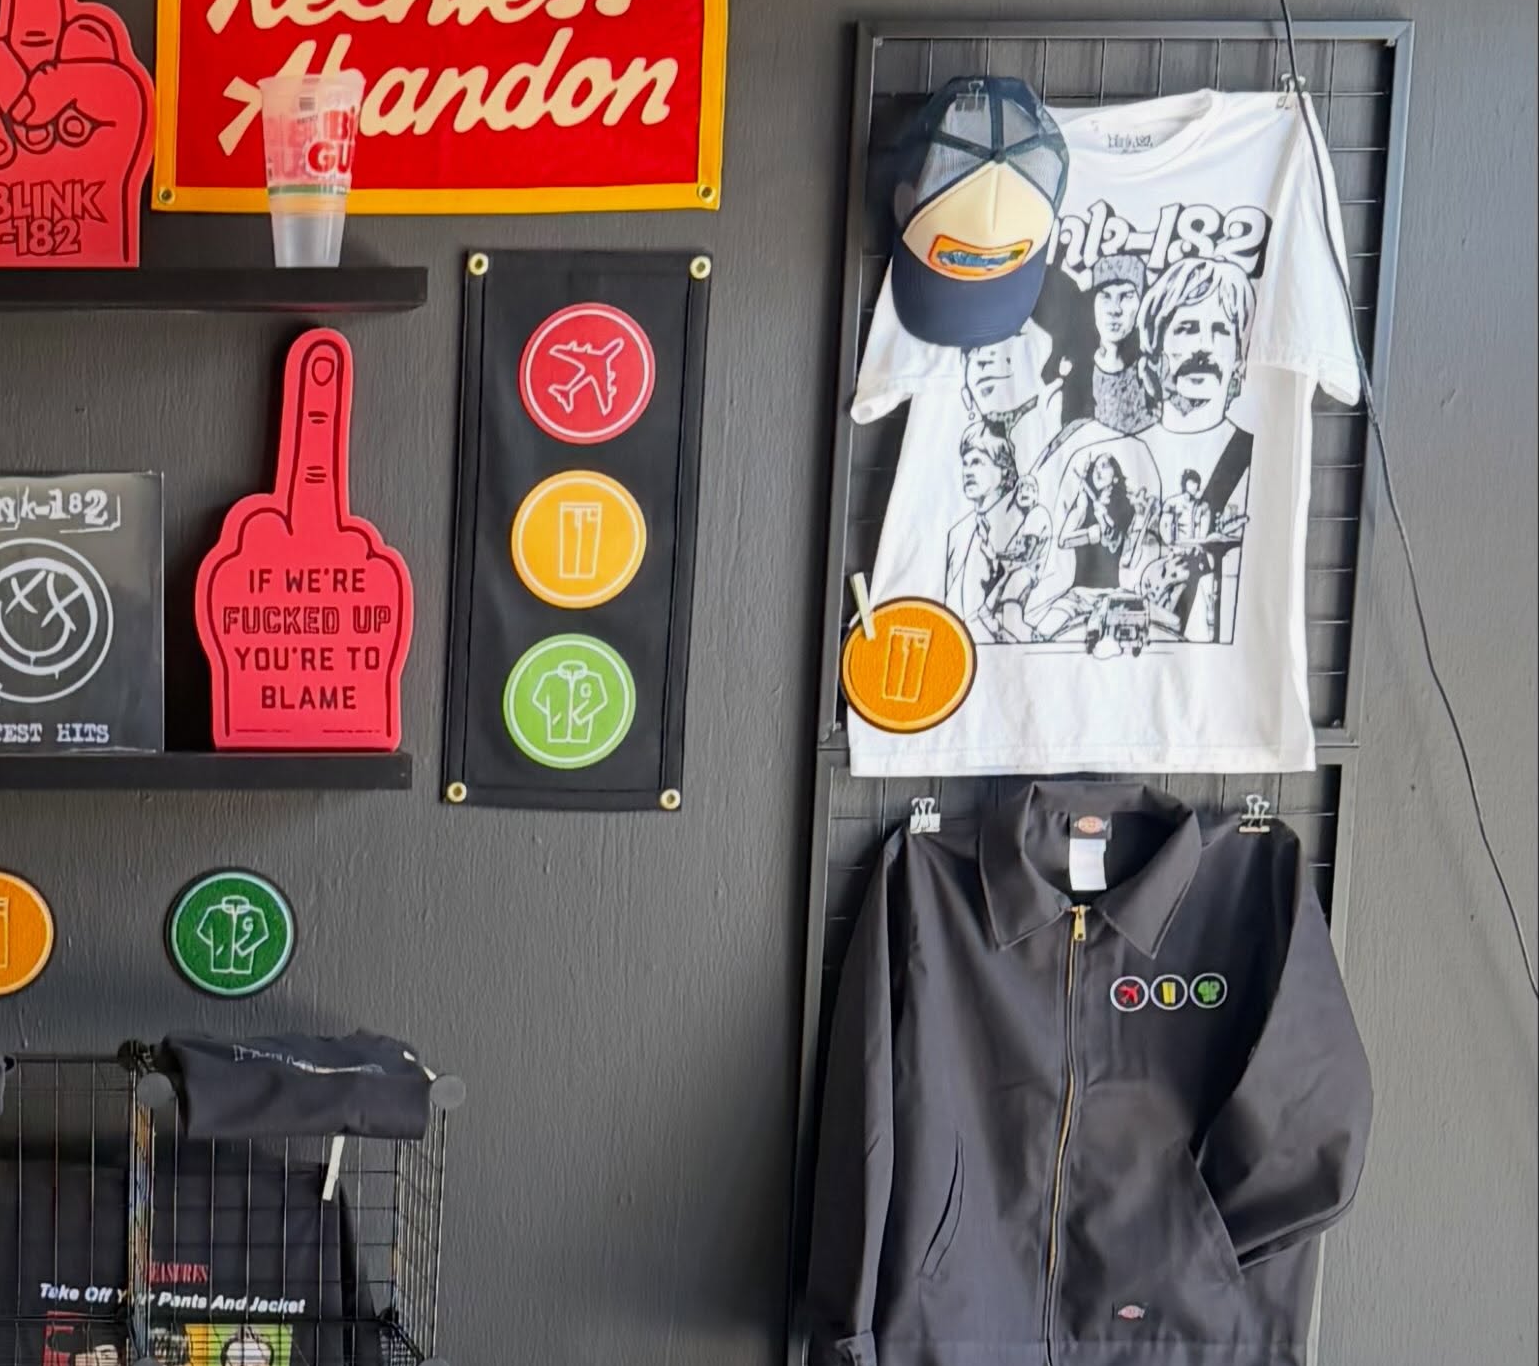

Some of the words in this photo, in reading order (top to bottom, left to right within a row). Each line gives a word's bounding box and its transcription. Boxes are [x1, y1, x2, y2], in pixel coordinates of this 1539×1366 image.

[1046, 198, 1273, 285] nk-182
[249, 568, 273, 594] IF
[285, 567, 366, 594] WE'RE
[223, 606, 340, 635] FUCKED
[352, 605, 392, 634] UP
[234, 646, 334, 671] YOU'RE
[346, 646, 380, 671] TO
[261, 685, 357, 710] BLAME
[56, 722, 110, 744] HITS
[40, 1283, 80, 1302] Take
[84, 1286, 114, 1304] Off
[157, 1291, 208, 1309] Pants
[211, 1294, 248, 1312] And
[249, 1296, 307, 1314] Jacket
